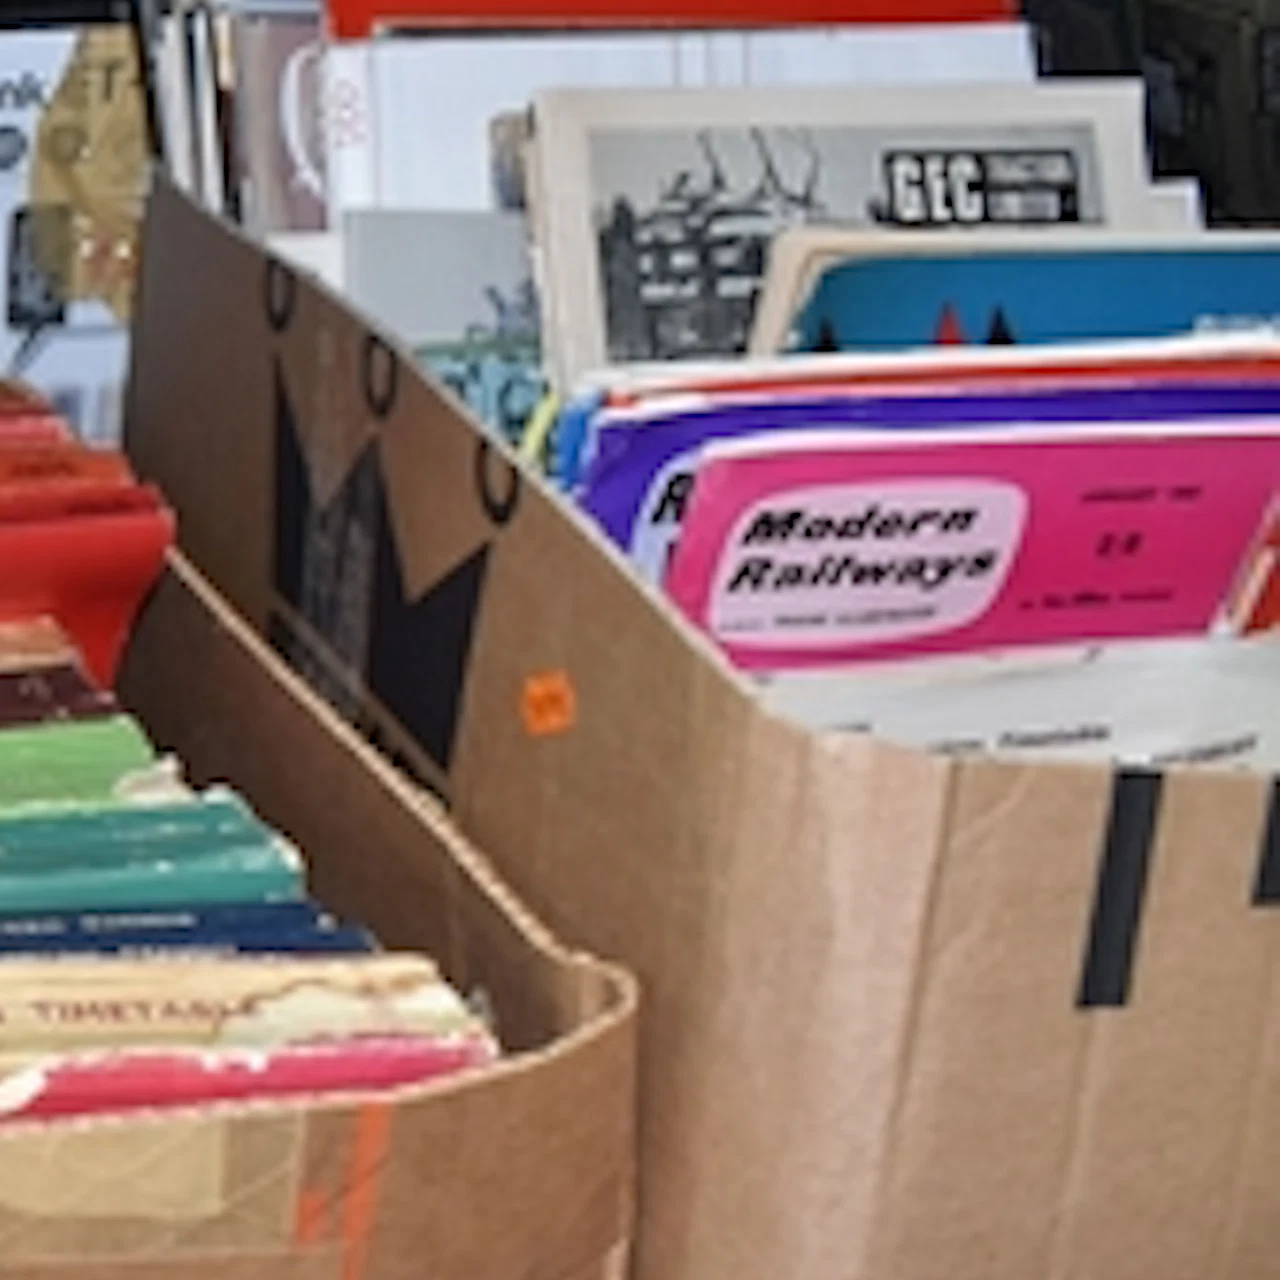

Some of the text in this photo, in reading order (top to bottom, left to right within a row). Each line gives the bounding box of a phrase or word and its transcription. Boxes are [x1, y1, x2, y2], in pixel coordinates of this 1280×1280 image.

[890, 152, 986, 223] GEC
[741, 503, 979, 547] Modern
[727, 549, 998, 594] Railways
